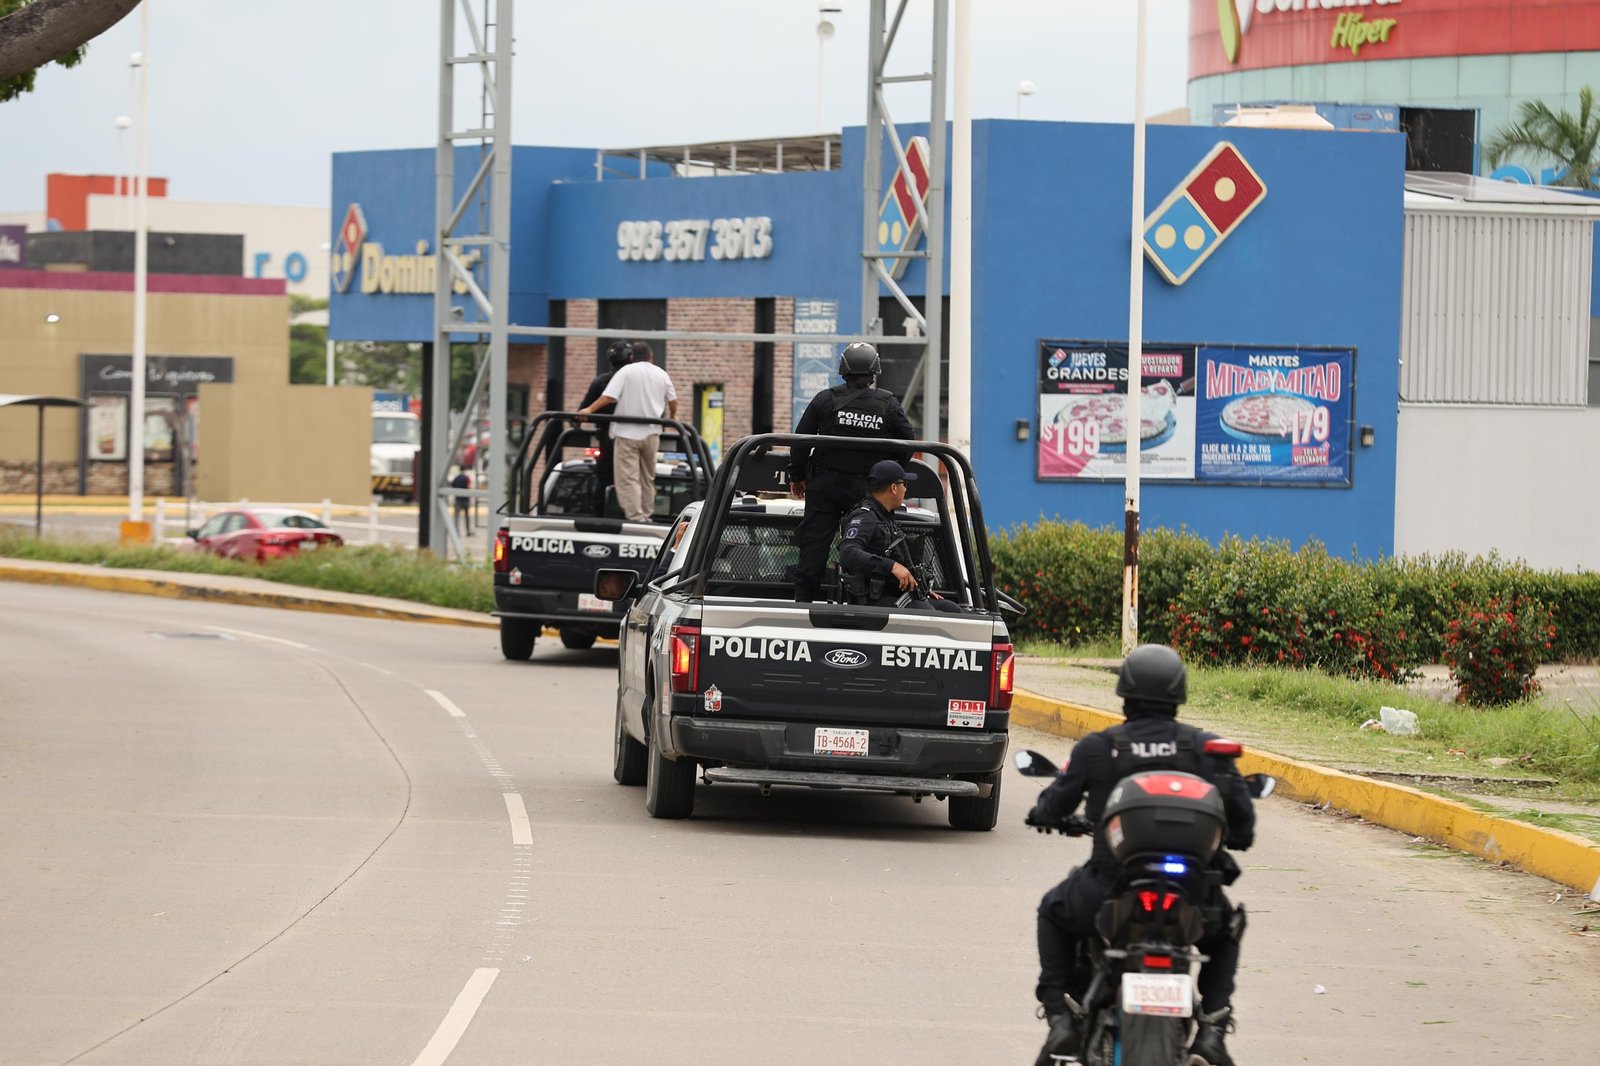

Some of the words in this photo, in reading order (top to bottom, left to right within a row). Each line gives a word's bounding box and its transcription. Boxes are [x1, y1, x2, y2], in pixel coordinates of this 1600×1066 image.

[1331, 12, 1398, 56] Hiper
[616, 220, 663, 261] 993
[663, 219, 711, 261] 357
[710, 216, 773, 260] 3613
[1070, 352, 1107, 367] JUEVES
[1249, 355, 1300, 367] MARTES
[1047, 367, 1129, 381] GRANDES
[1206, 360, 1269, 400] MITAD
[1266, 369, 1279, 393] Y
[1275, 362, 1341, 402] MITAD
[838, 417, 881, 430] ESTATAL
[1278, 405, 1330, 446] $179
[1042, 417, 1101, 457] $199
[1220, 443, 1229, 453] DE
[511, 536, 575, 555] POLICIA
[708, 635, 812, 663] POLICIA
[832, 650, 860, 665] Ford
[880, 645, 984, 672] ESTATAL
[951, 700, 984, 713] 911
[816, 735, 867, 749] TB-456A-2
